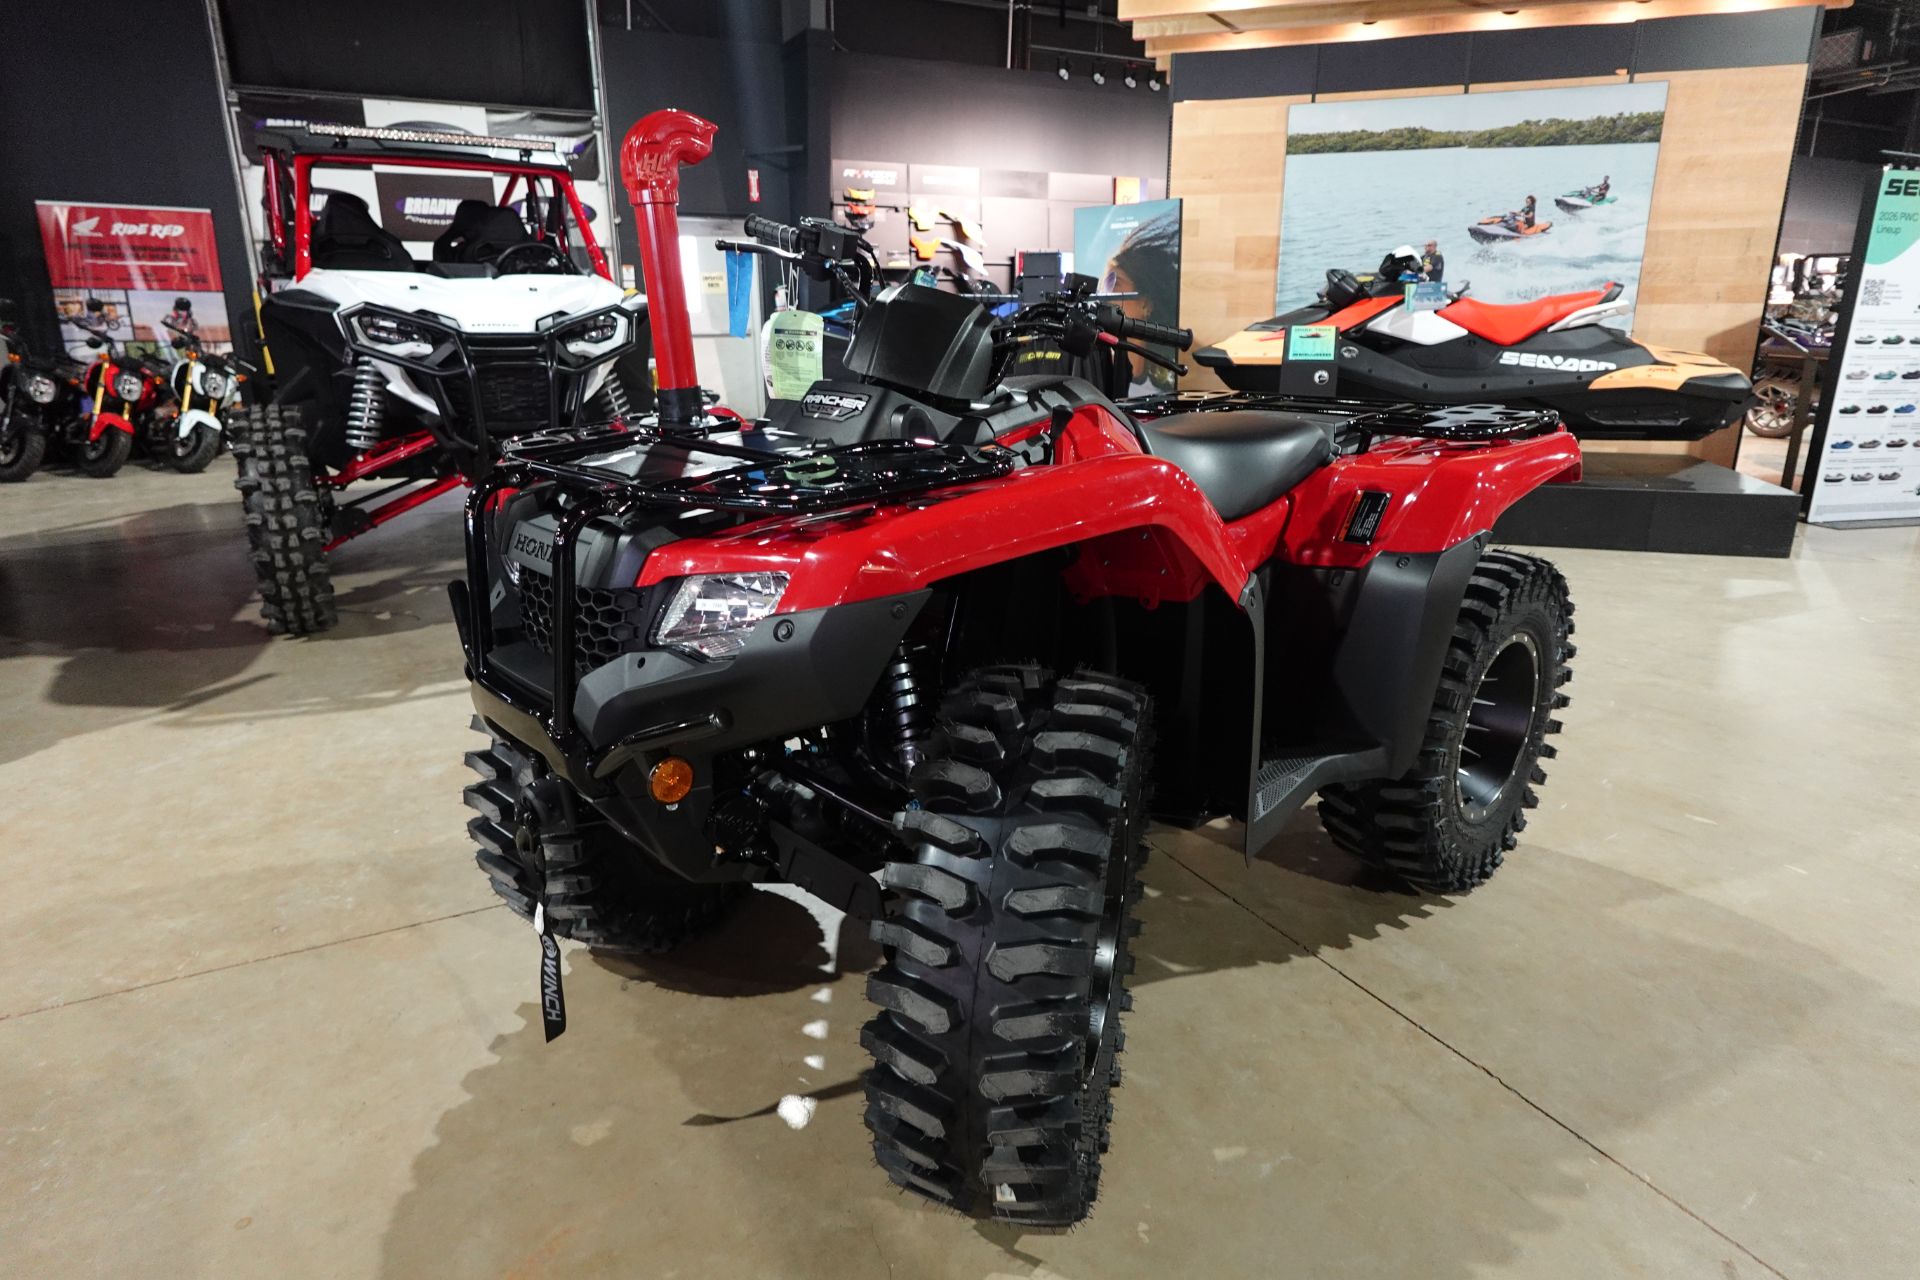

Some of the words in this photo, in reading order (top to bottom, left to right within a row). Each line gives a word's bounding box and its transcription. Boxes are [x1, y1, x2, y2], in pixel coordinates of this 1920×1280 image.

[403, 196, 463, 216] BROADW
[1900, 212, 1919, 222] PWC
[112, 222, 148, 236] RIDE
[151, 223, 185, 238] RED
[1876, 225, 1902, 236] Lineup
[804, 395, 866, 411] RANCHER
[514, 533, 553, 563] HON
[544, 958, 561, 1020] WINCH
